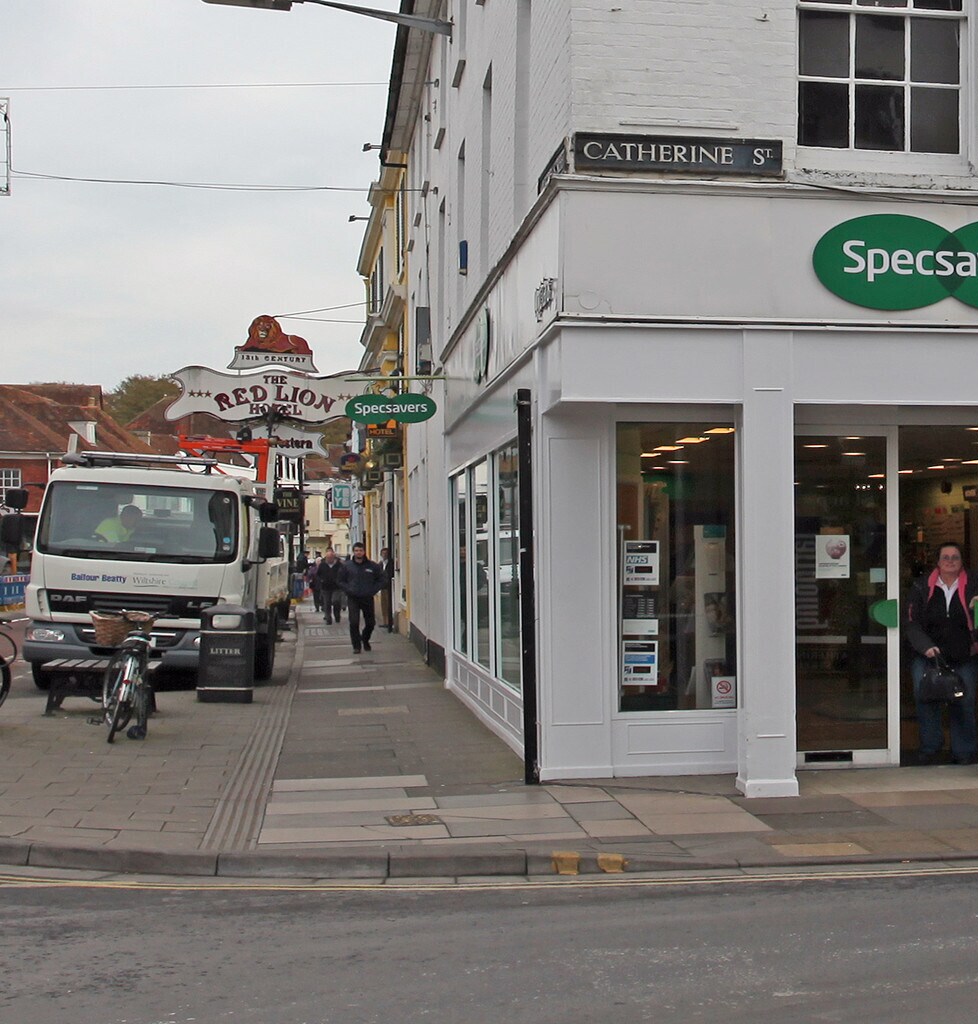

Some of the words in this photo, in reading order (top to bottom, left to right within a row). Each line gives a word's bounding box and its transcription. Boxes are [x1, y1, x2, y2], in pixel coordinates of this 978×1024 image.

[583, 141, 733, 167] CATHERINE
[264, 355, 306, 363] CENTURY
[263, 375, 288, 384] THE
[213, 385, 268, 411] RED
[274, 386, 337, 414] LION
[354, 402, 428, 417] Specsavers
[276, 498, 299, 508] VINE
[626, 556, 647, 564] NHS
[71, 573, 100, 581] Balfour
[101, 574, 127, 584] Beatty
[132, 576, 167, 585] Wiltshire
[50, 593, 88, 603] DAF
[210, 647, 241, 656] LITTER
